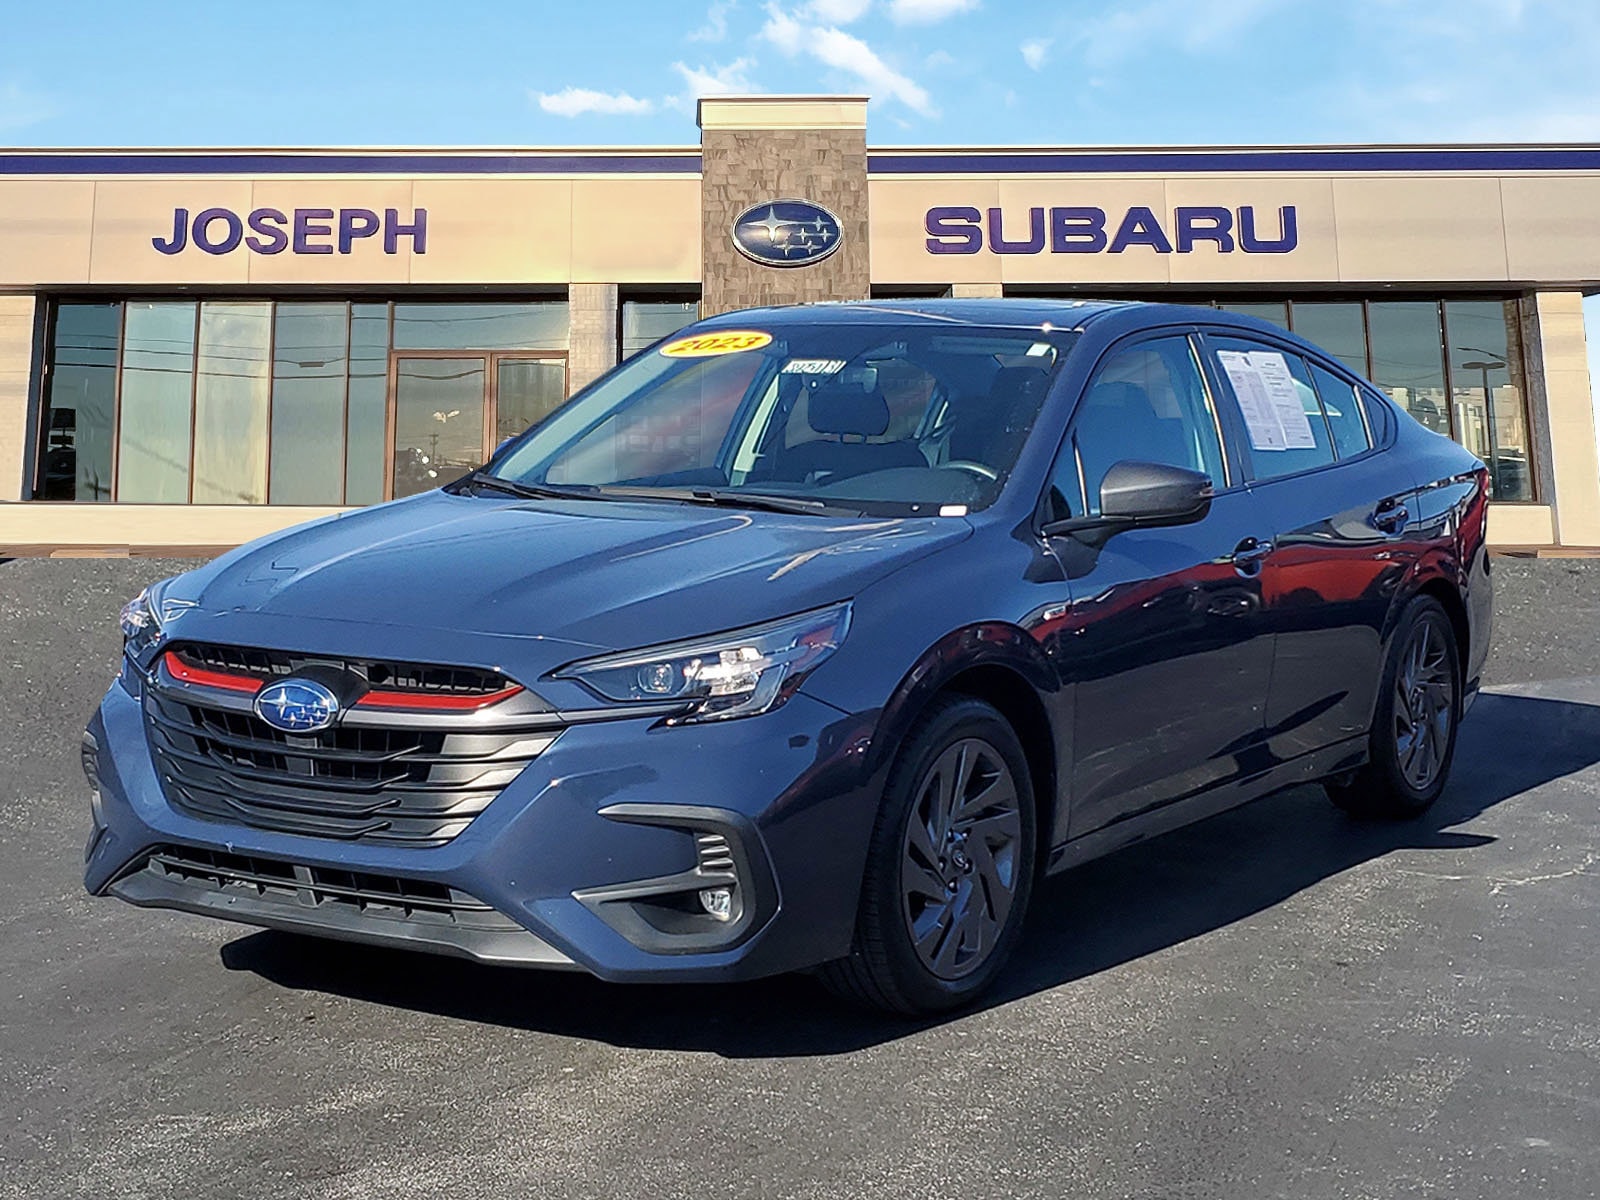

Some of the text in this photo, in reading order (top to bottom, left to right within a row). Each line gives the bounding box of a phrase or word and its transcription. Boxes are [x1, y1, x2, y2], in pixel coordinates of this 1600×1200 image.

[151, 208, 427, 255] JOSEPH
[925, 206, 1298, 254] SUBARU
[667, 335, 764, 354] 2023
